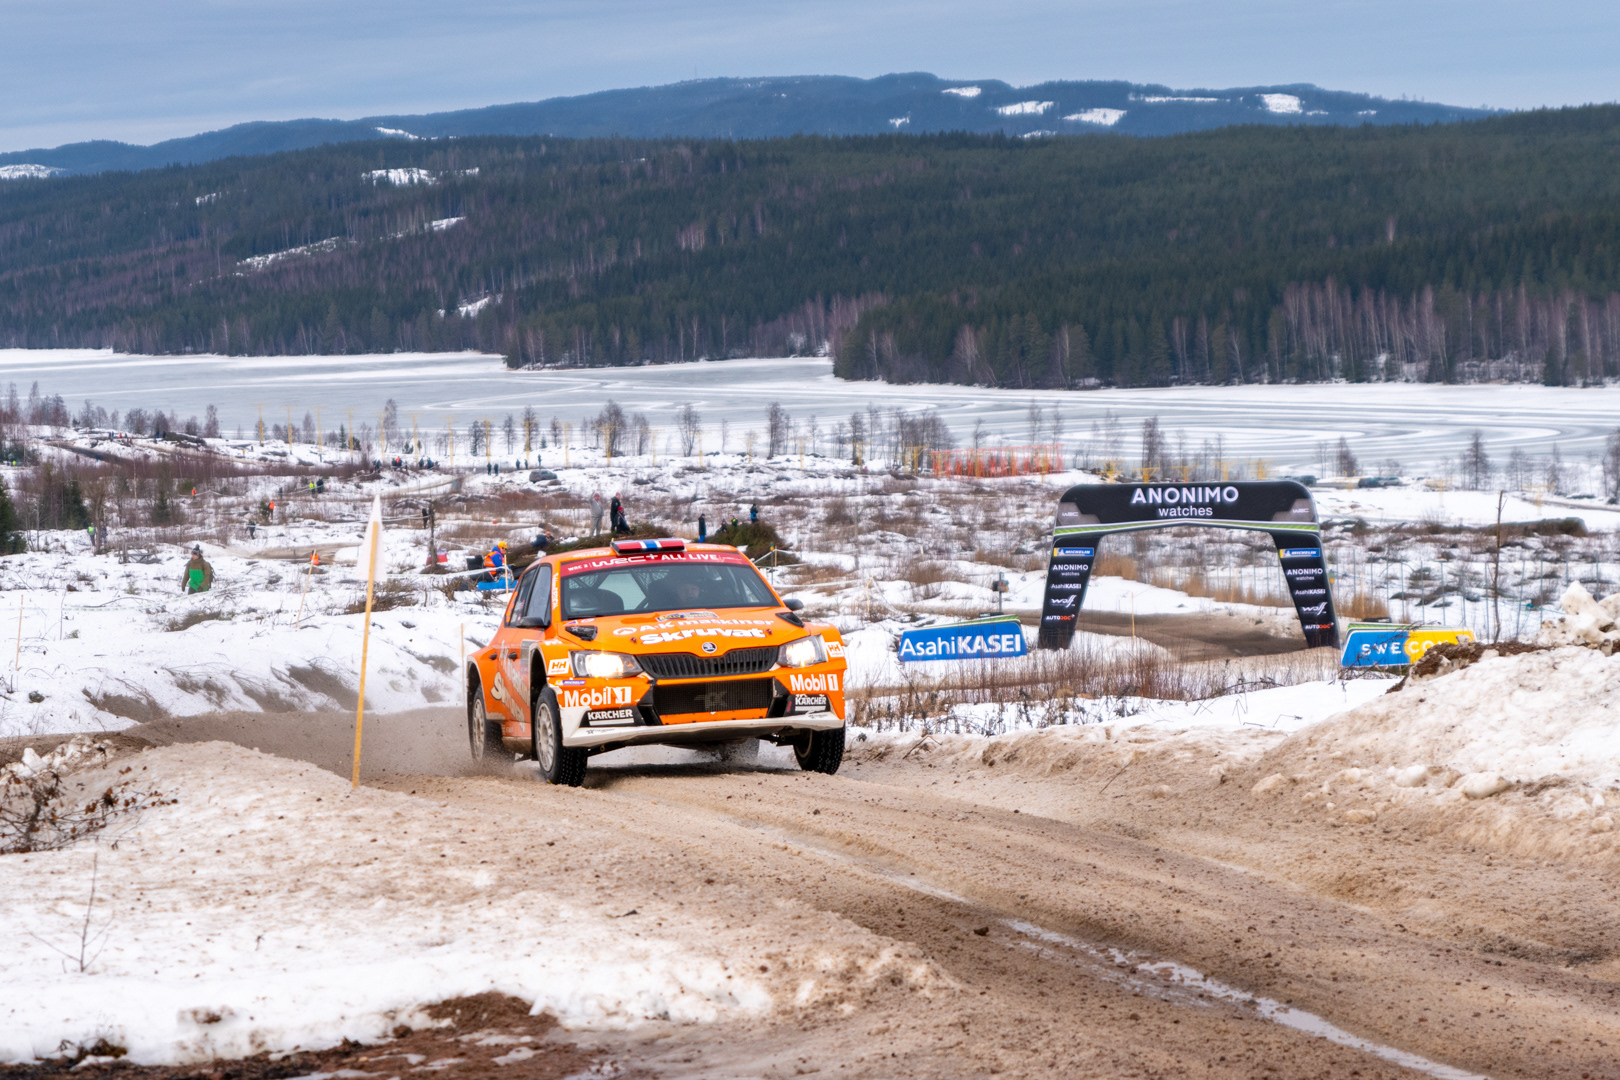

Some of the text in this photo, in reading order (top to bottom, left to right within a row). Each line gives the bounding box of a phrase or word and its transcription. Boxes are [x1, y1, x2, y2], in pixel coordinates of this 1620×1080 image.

[1131, 486, 1239, 504] ANONIMO
[1158, 505, 1213, 517] watches
[1287, 568, 1324, 576] ANONIMO
[640, 627, 767, 645] Skruvat
[900, 634, 1021, 656] AsahiKASEI
[789, 674, 827, 691] Mobil
[564, 686, 612, 708] Mobil
